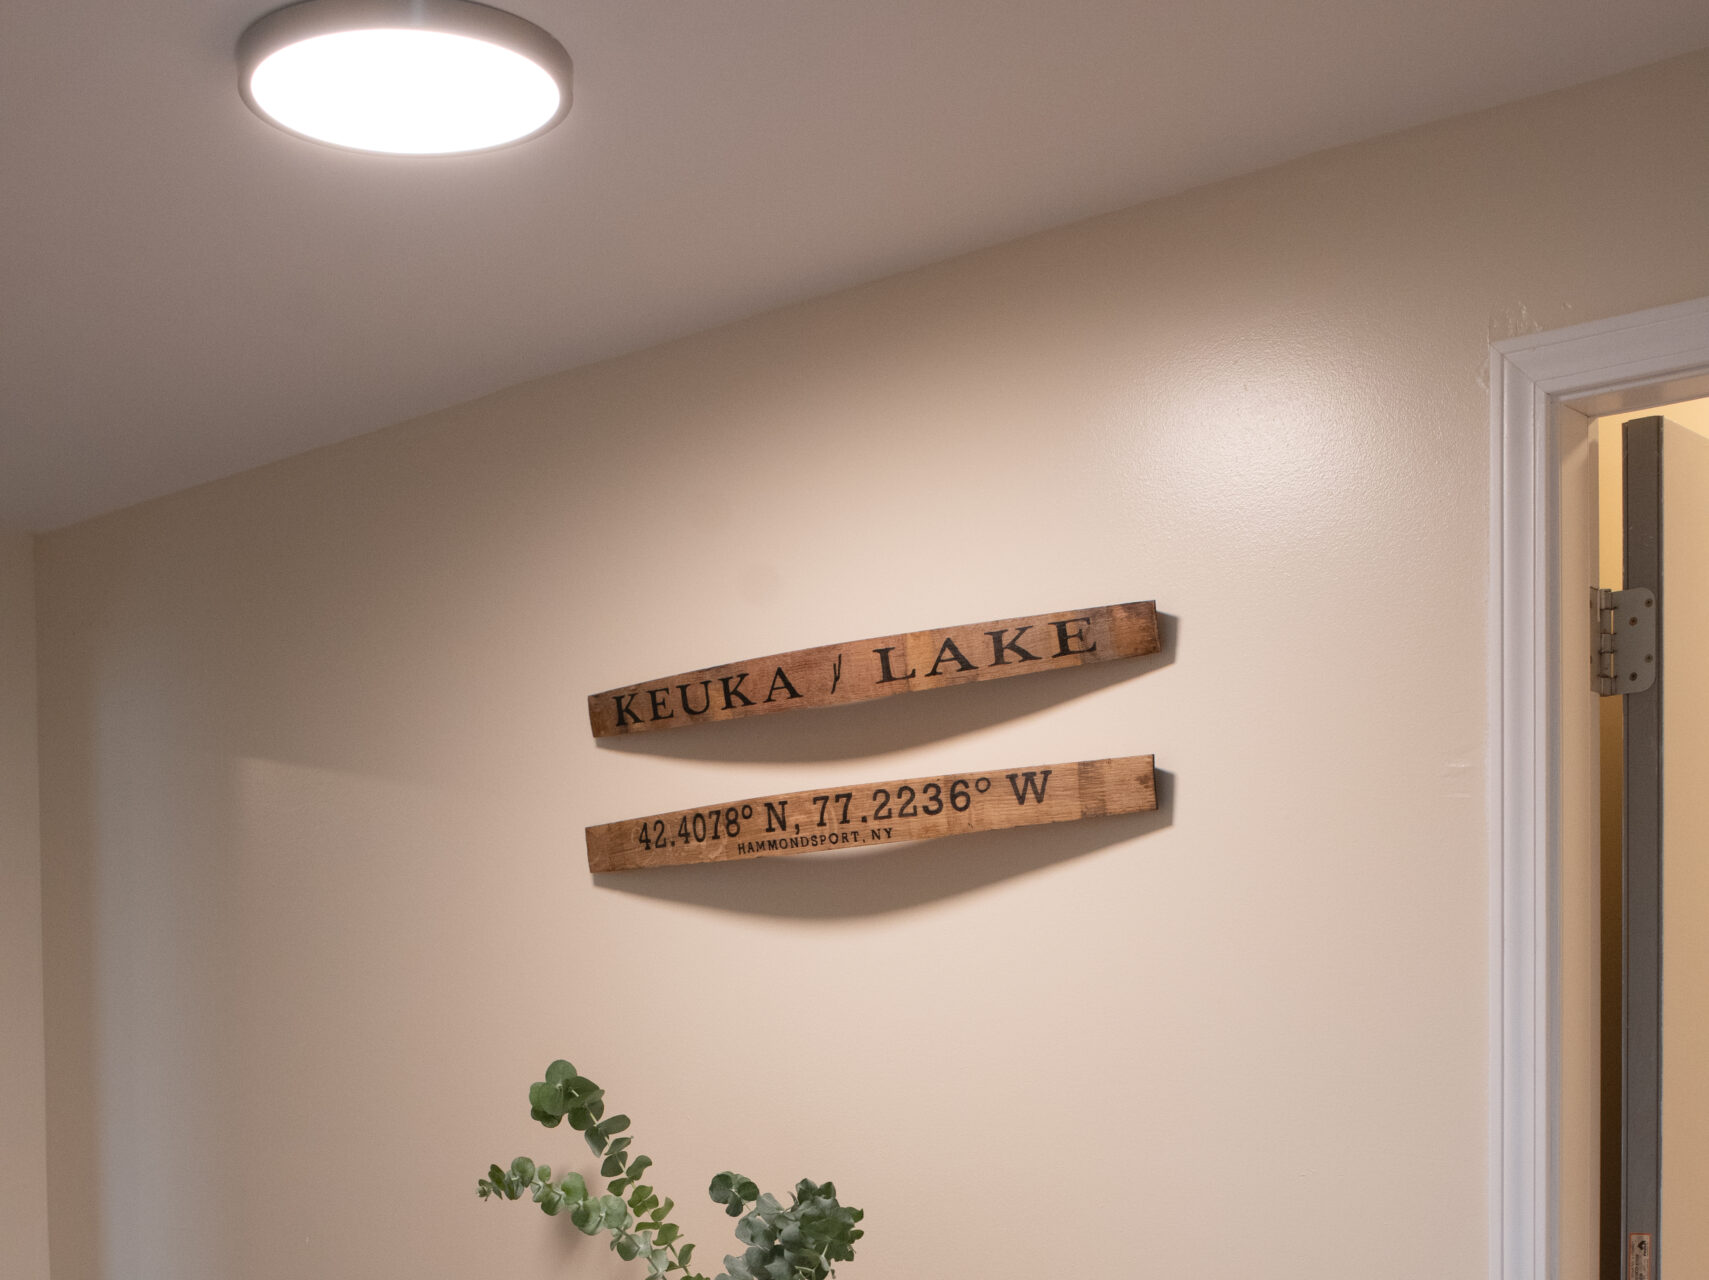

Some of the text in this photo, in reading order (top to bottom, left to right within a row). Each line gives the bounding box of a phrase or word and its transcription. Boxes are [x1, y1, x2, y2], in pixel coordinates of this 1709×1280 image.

[612, 616, 1098, 727] KEUKA LAKE
[764, 800, 800, 836] N,
[1006, 769, 1053, 806] W
[737, 826, 893, 855] HAMMONDSPORT, NY
